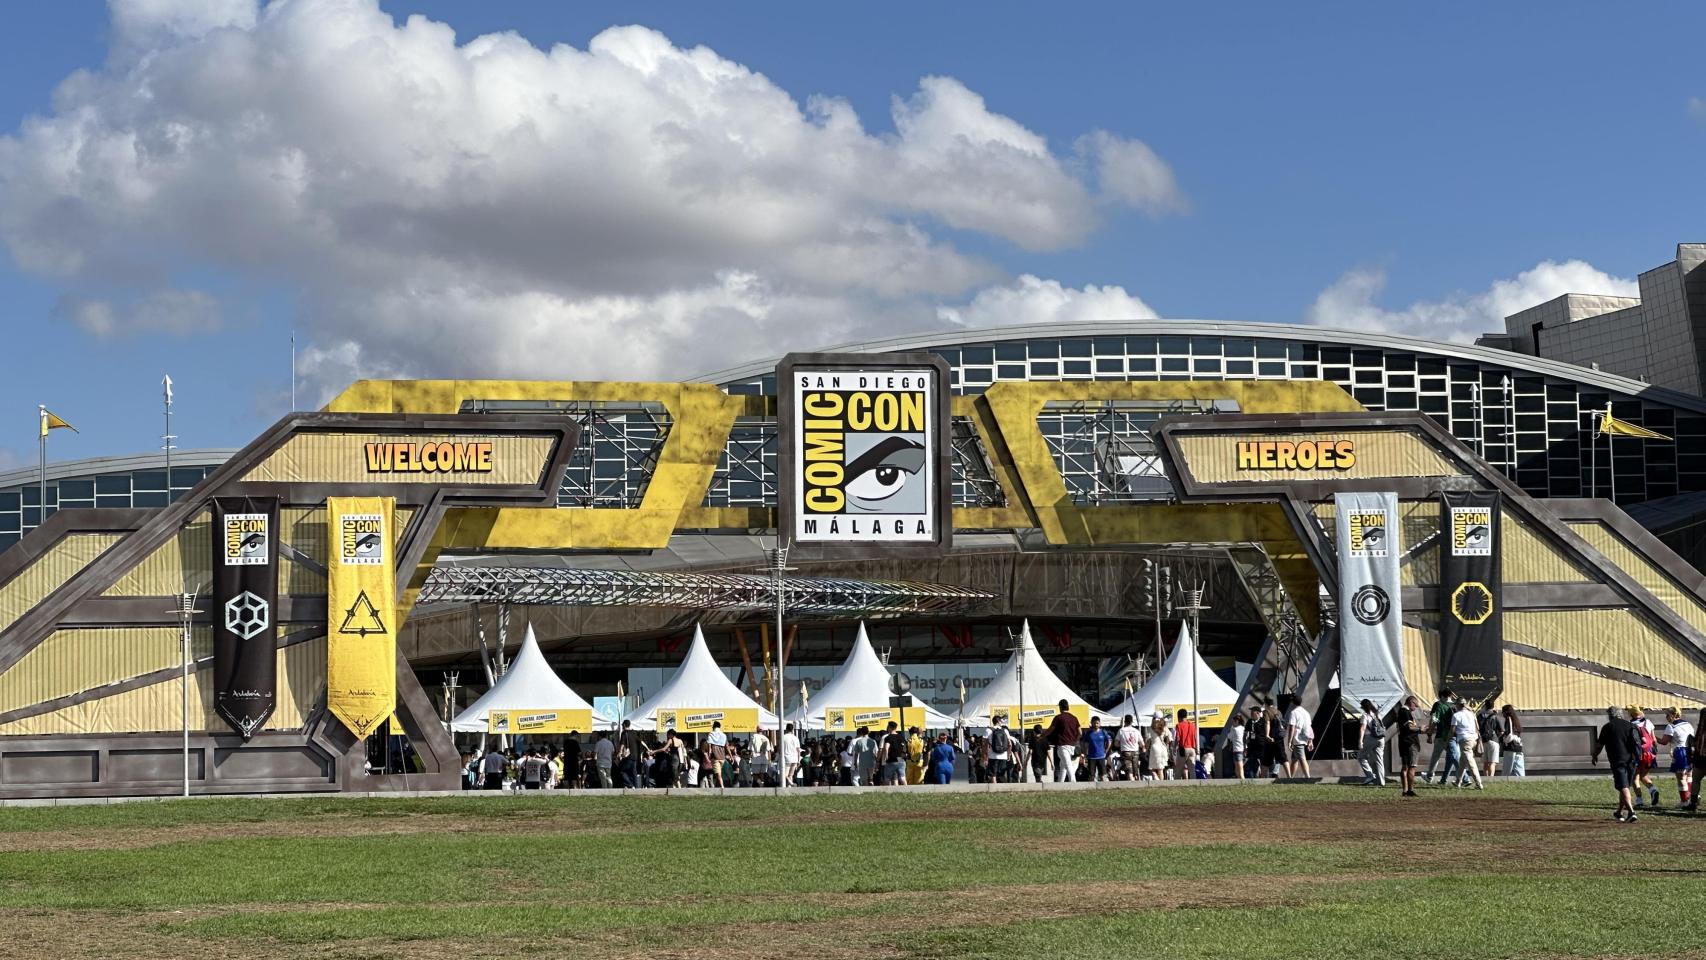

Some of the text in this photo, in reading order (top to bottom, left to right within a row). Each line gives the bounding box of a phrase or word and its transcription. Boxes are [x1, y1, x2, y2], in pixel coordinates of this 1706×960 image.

[801, 376, 926, 389] SAN DIEGO
[847, 391, 925, 432] CON
[364, 442, 493, 473] WELCOME
[804, 392, 845, 513] COMIC
[1235, 440, 1357, 472] HEROES
[240, 520, 266, 533] CON
[356, 520, 380, 533] CON
[804, 515, 926, 535] MÁLAGA
[1350, 515, 1363, 550] COMIC
[1362, 514, 1385, 527] CON
[1454, 513, 1466, 548] COMIC
[1465, 513, 1488, 525] CON
[227, 520, 241, 557] COMIC
[343, 520, 357, 557] COMIC
[937, 678, 948, 692] y
